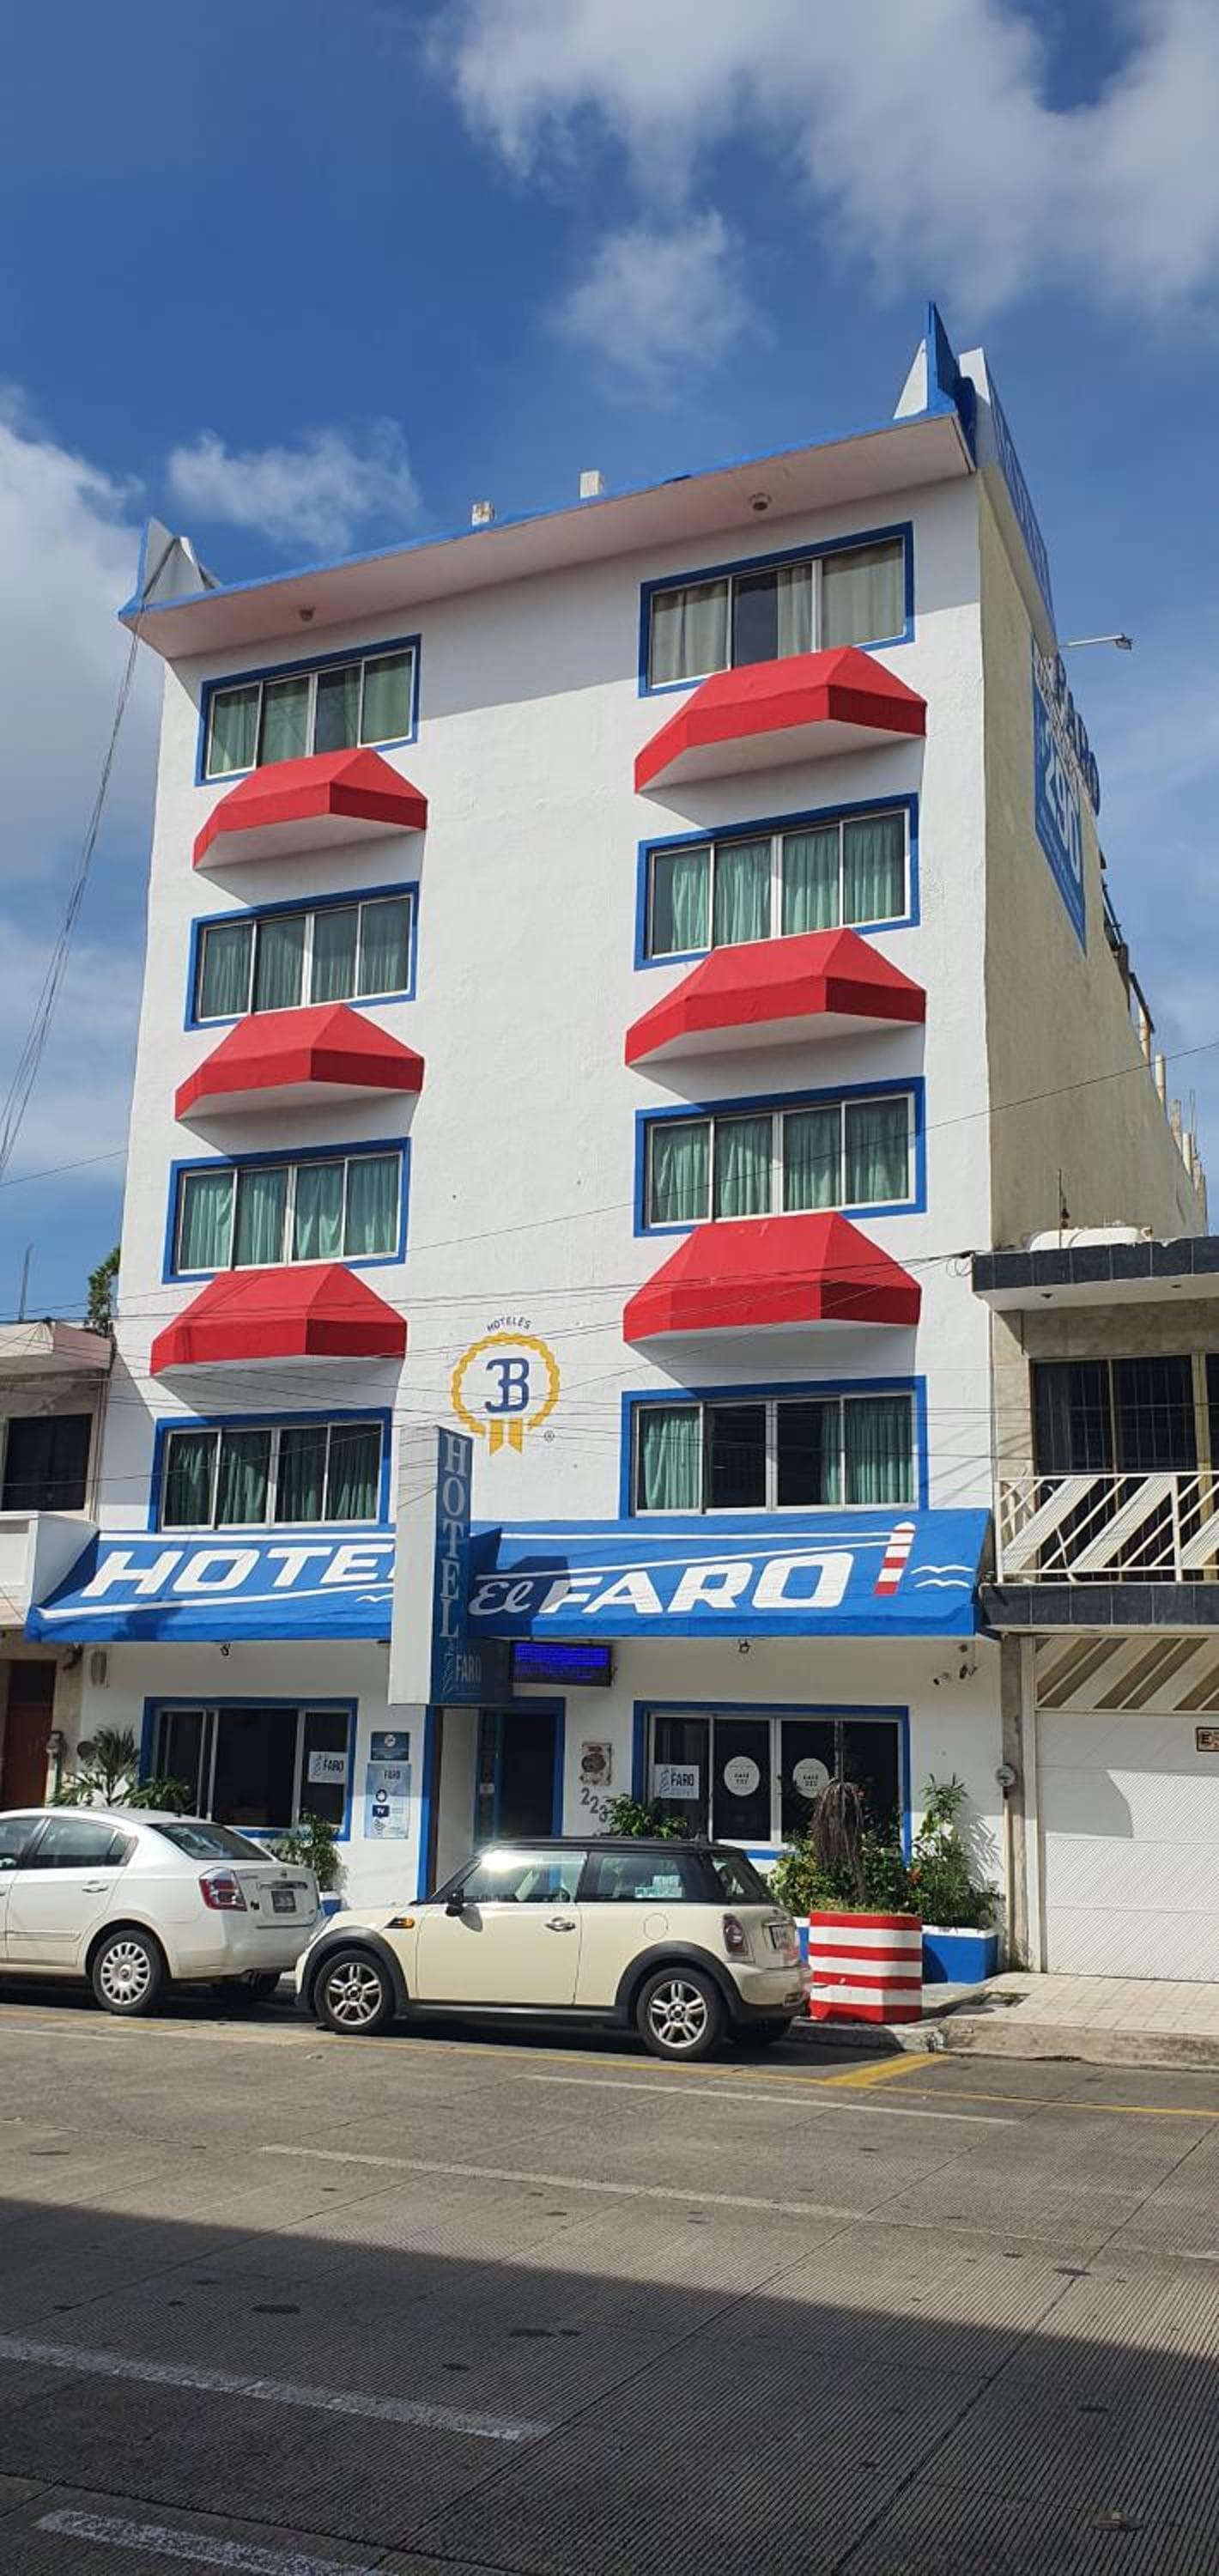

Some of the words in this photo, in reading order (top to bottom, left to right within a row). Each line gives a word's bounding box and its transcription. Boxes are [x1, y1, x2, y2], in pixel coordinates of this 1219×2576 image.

[487, 1315, 531, 1332] HOTELES
[440, 1433, 468, 1637] HOTEL
[81, 1543, 396, 1598] HOTE
[468, 1581, 534, 1616] El
[538, 1552, 854, 1615] FARO
[456, 1652, 482, 1682] FARO
[322, 1759, 344, 1773] FARO
[670, 1772, 694, 1787] FARO
